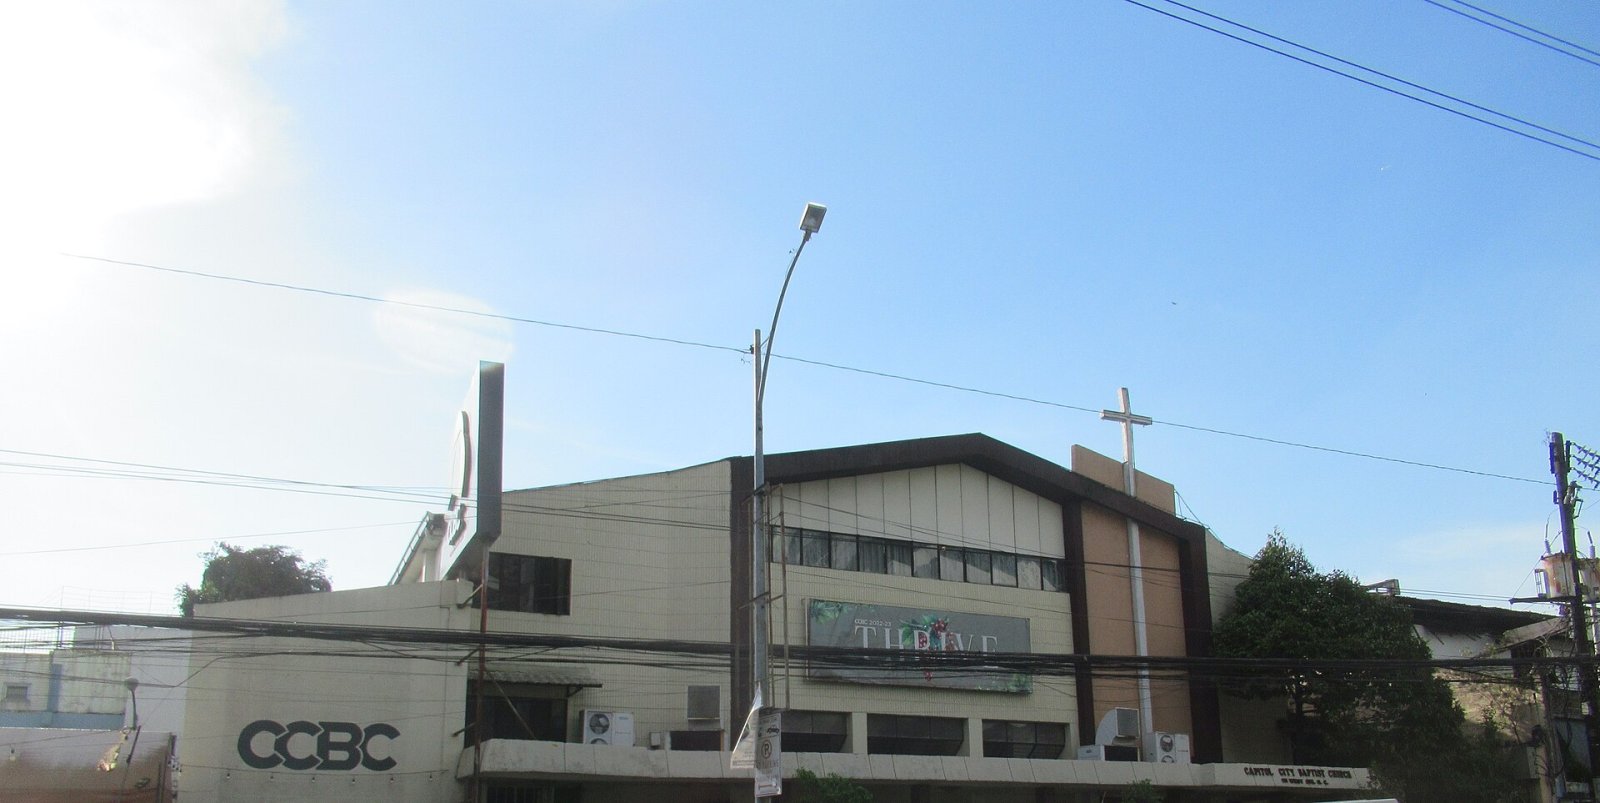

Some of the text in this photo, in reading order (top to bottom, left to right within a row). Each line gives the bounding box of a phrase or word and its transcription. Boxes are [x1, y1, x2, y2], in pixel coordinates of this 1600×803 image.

[237, 719, 401, 771] CCBC
[1243, 767, 1352, 779] CAPITOL CITY BAPTIST CHURCH
